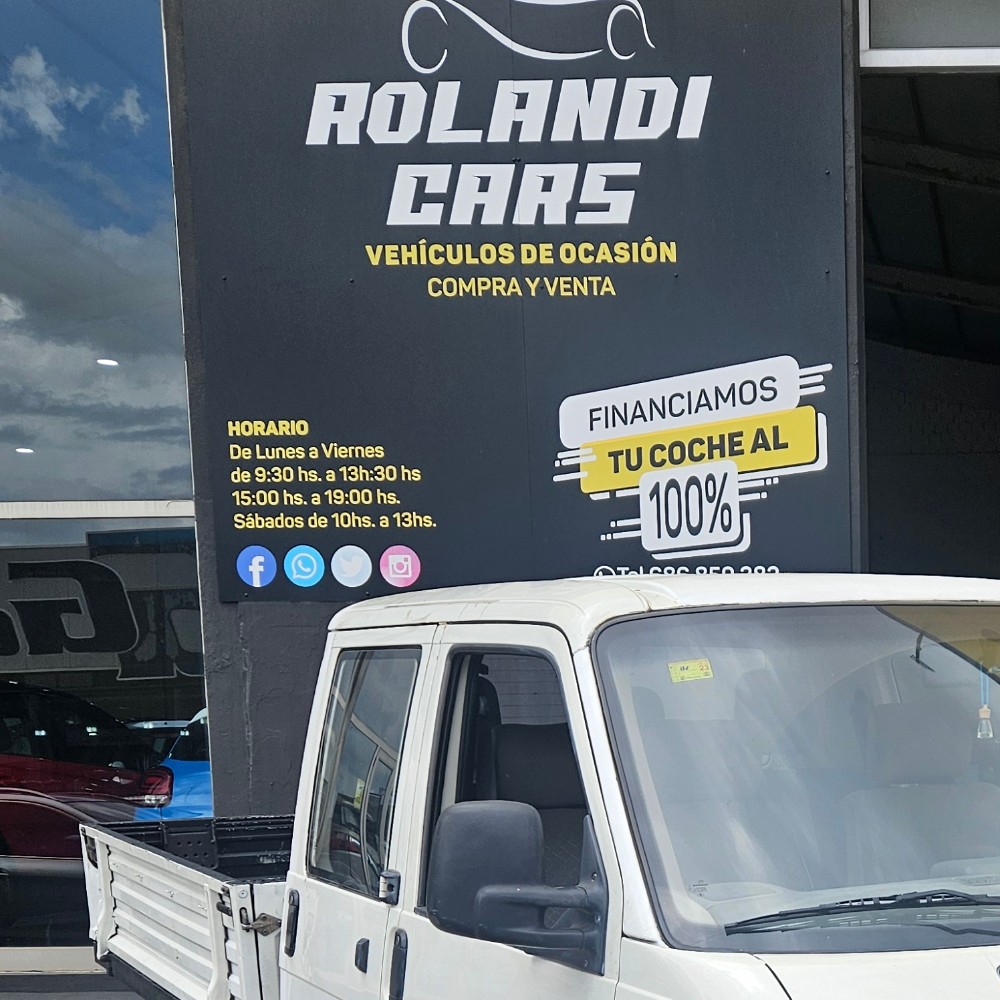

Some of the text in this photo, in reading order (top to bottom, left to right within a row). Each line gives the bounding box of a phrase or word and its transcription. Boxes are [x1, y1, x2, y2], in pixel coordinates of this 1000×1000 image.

[306, 76, 712, 145] ROLANDI
[387, 163, 641, 225] CARS
[365, 236, 676, 265] VEHÍCULOS DE OCASIÓN
[428, 277, 616, 297] COMPRA Y VENTA
[589, 375, 778, 431] FINANCIAMOS
[228, 420, 308, 436] HORARIO
[230, 443, 384, 459] De Lunes a Viernes
[608, 426, 788, 473] TU COCHE AL
[231, 465, 421, 483] de 9:30 hs. a 13h:30 hs
[232, 489, 400, 505] 15:00 hs. a 19:00 hs.
[649, 473, 732, 539] 100%
[234, 512, 436, 529] Sábados de 10hs. a 13hs.
